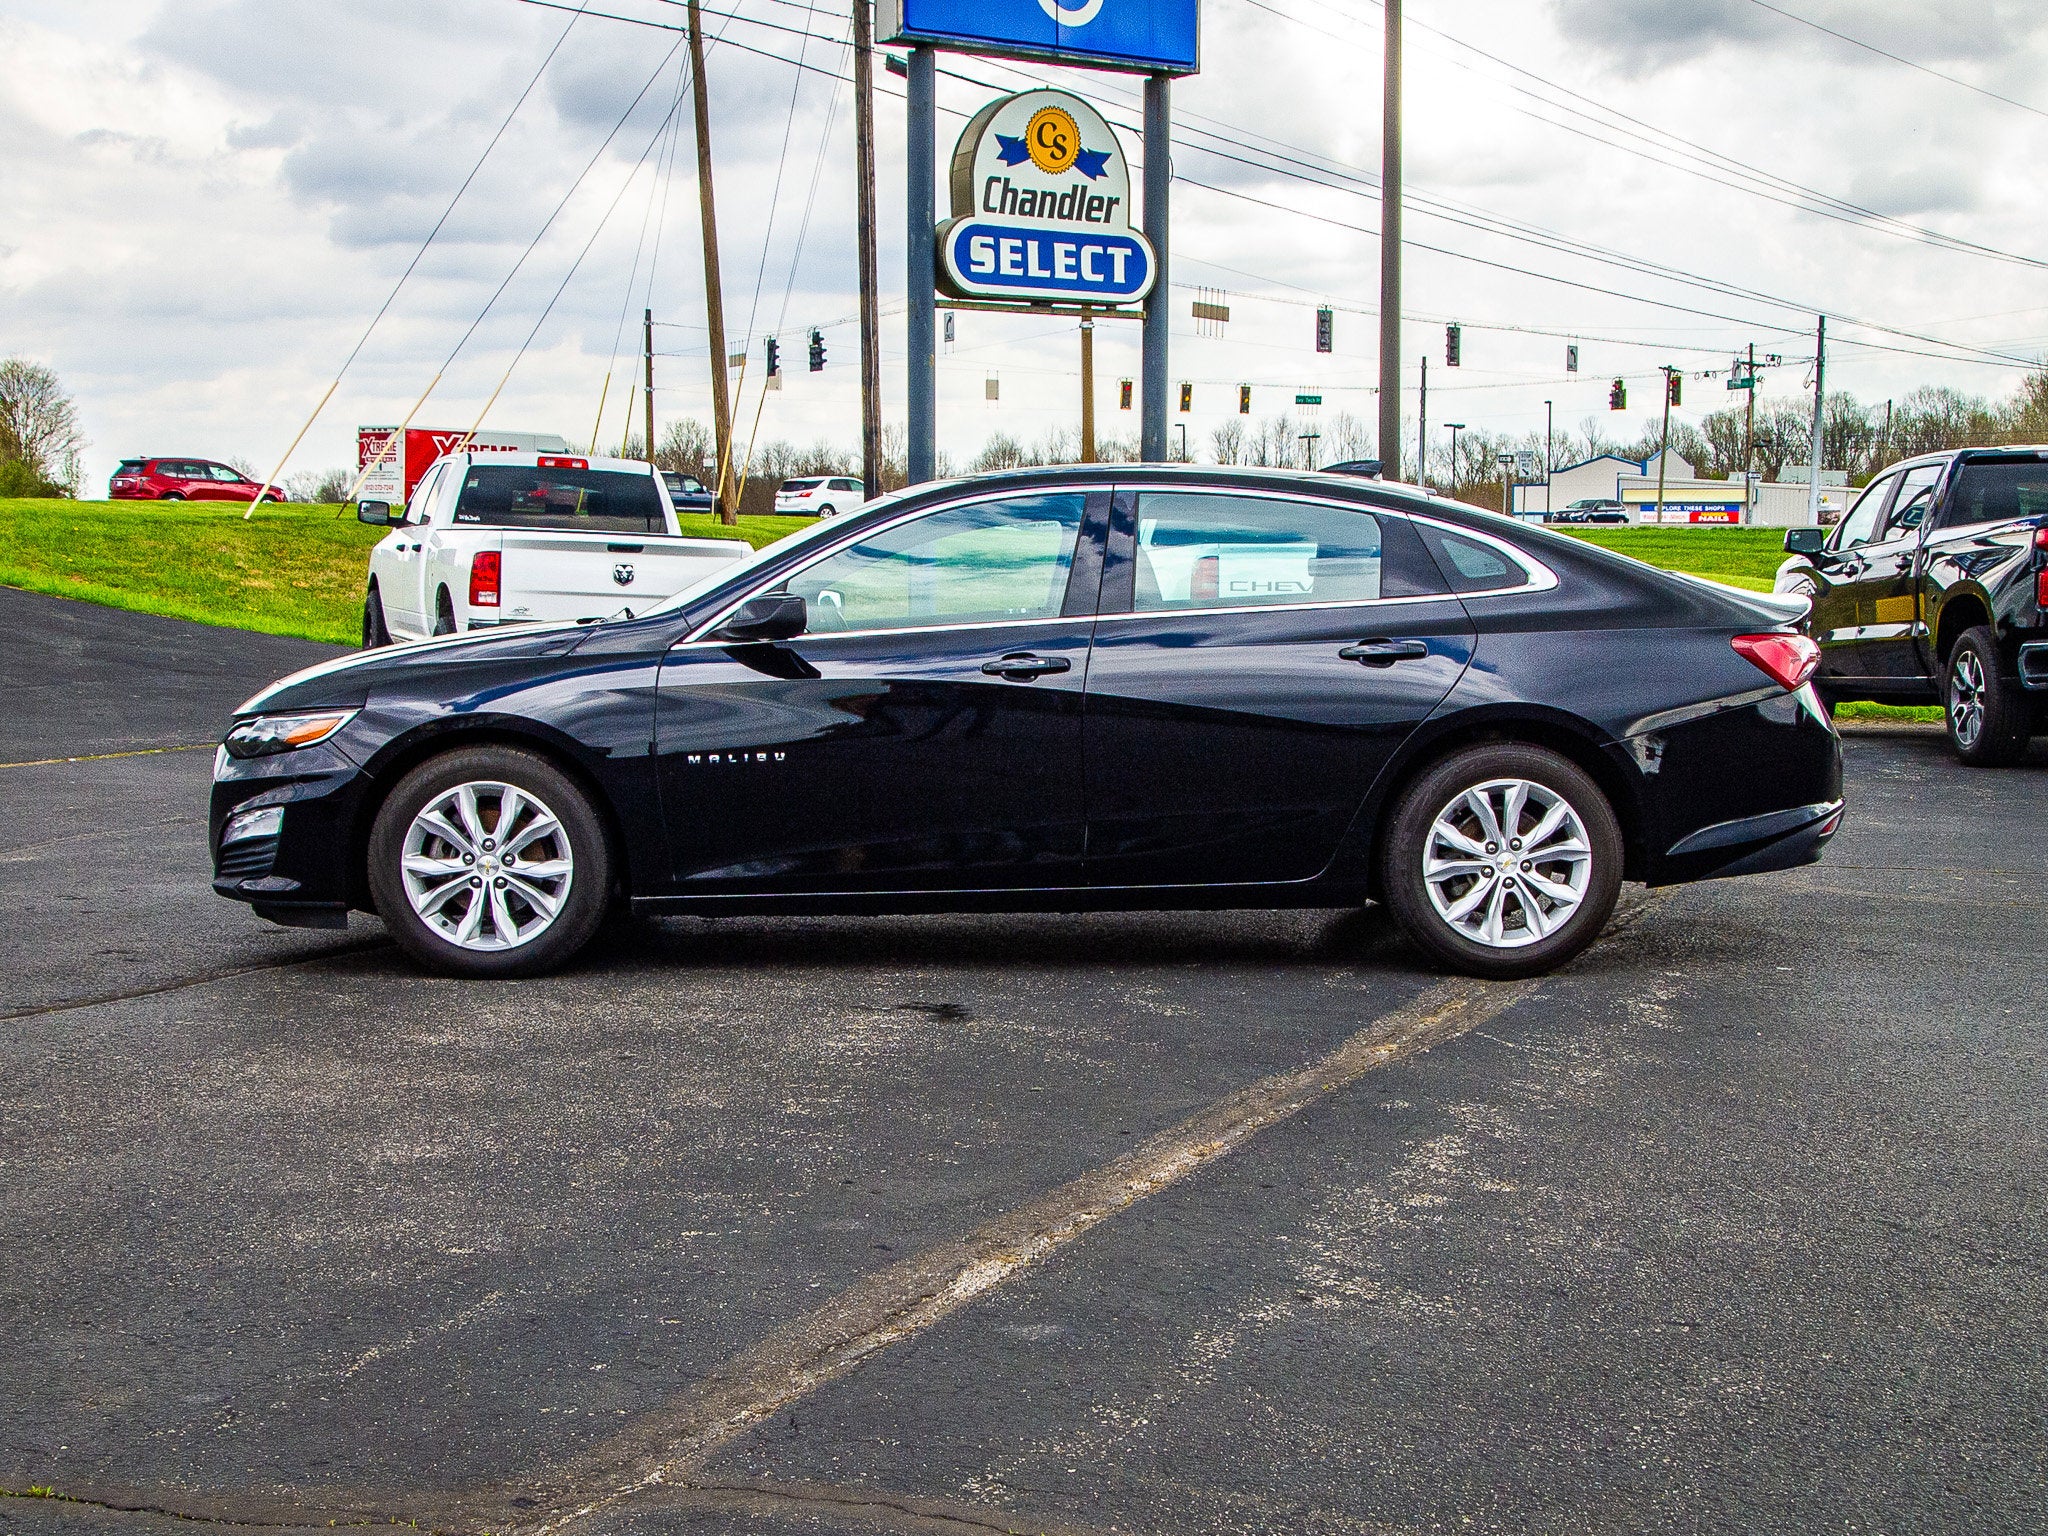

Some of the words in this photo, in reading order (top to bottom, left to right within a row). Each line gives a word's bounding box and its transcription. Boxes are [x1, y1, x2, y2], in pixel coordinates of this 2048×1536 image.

[983, 176, 1120, 224] Chandler
[970, 235, 1132, 284] SELECT
[688, 752, 785, 764] MALIBU
